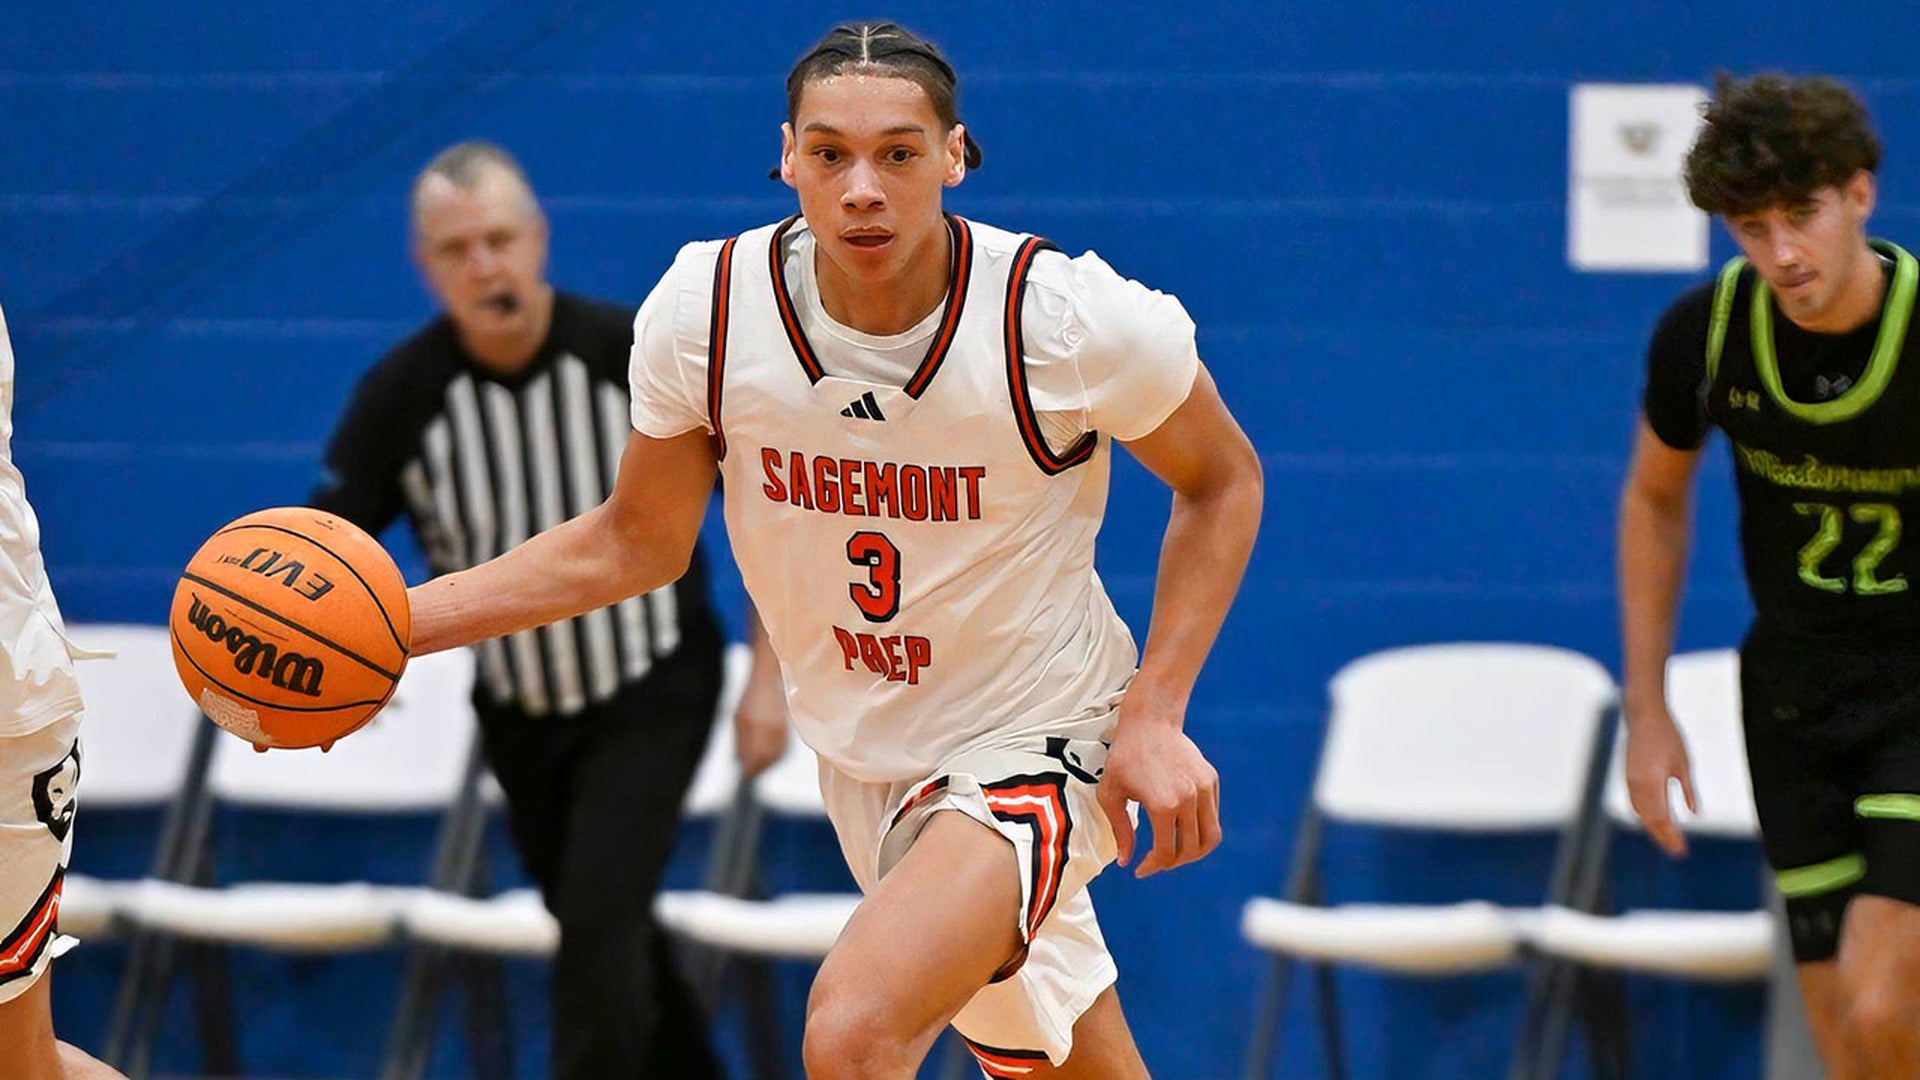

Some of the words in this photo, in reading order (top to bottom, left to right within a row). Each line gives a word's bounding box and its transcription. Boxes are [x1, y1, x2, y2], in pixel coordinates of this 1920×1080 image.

[761, 447, 986, 522] SAGEMONT
[239, 547, 335, 601] EVO
[846, 531, 901, 623] 3
[1793, 502, 1909, 595] 22
[188, 592, 325, 697] Wilson
[832, 625, 932, 685] PREP
